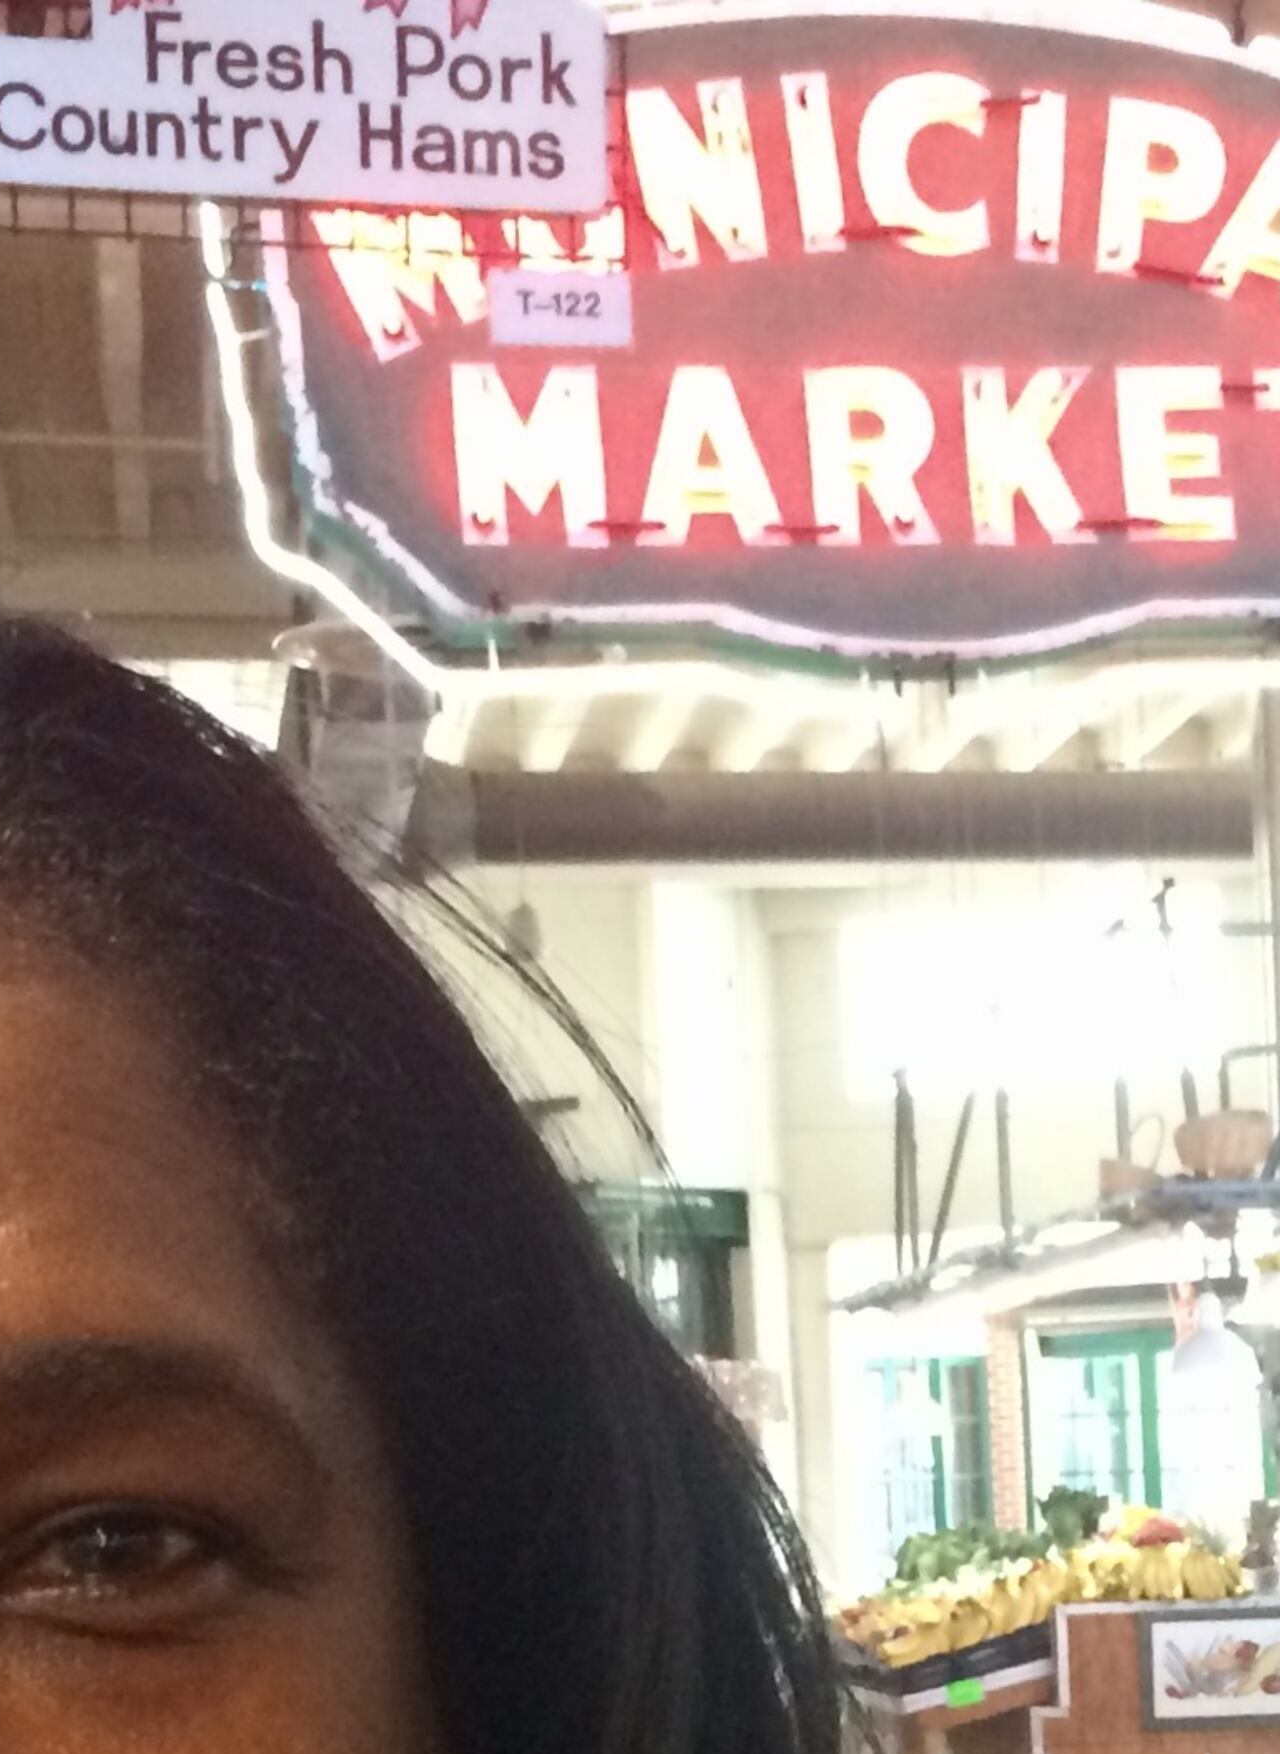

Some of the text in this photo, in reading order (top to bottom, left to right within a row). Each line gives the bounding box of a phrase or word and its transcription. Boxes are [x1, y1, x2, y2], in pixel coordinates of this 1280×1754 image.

[144, 10, 578, 107] Fresh Pork
[357, 101, 566, 181] Hams
[515, 289, 604, 319] T-122
